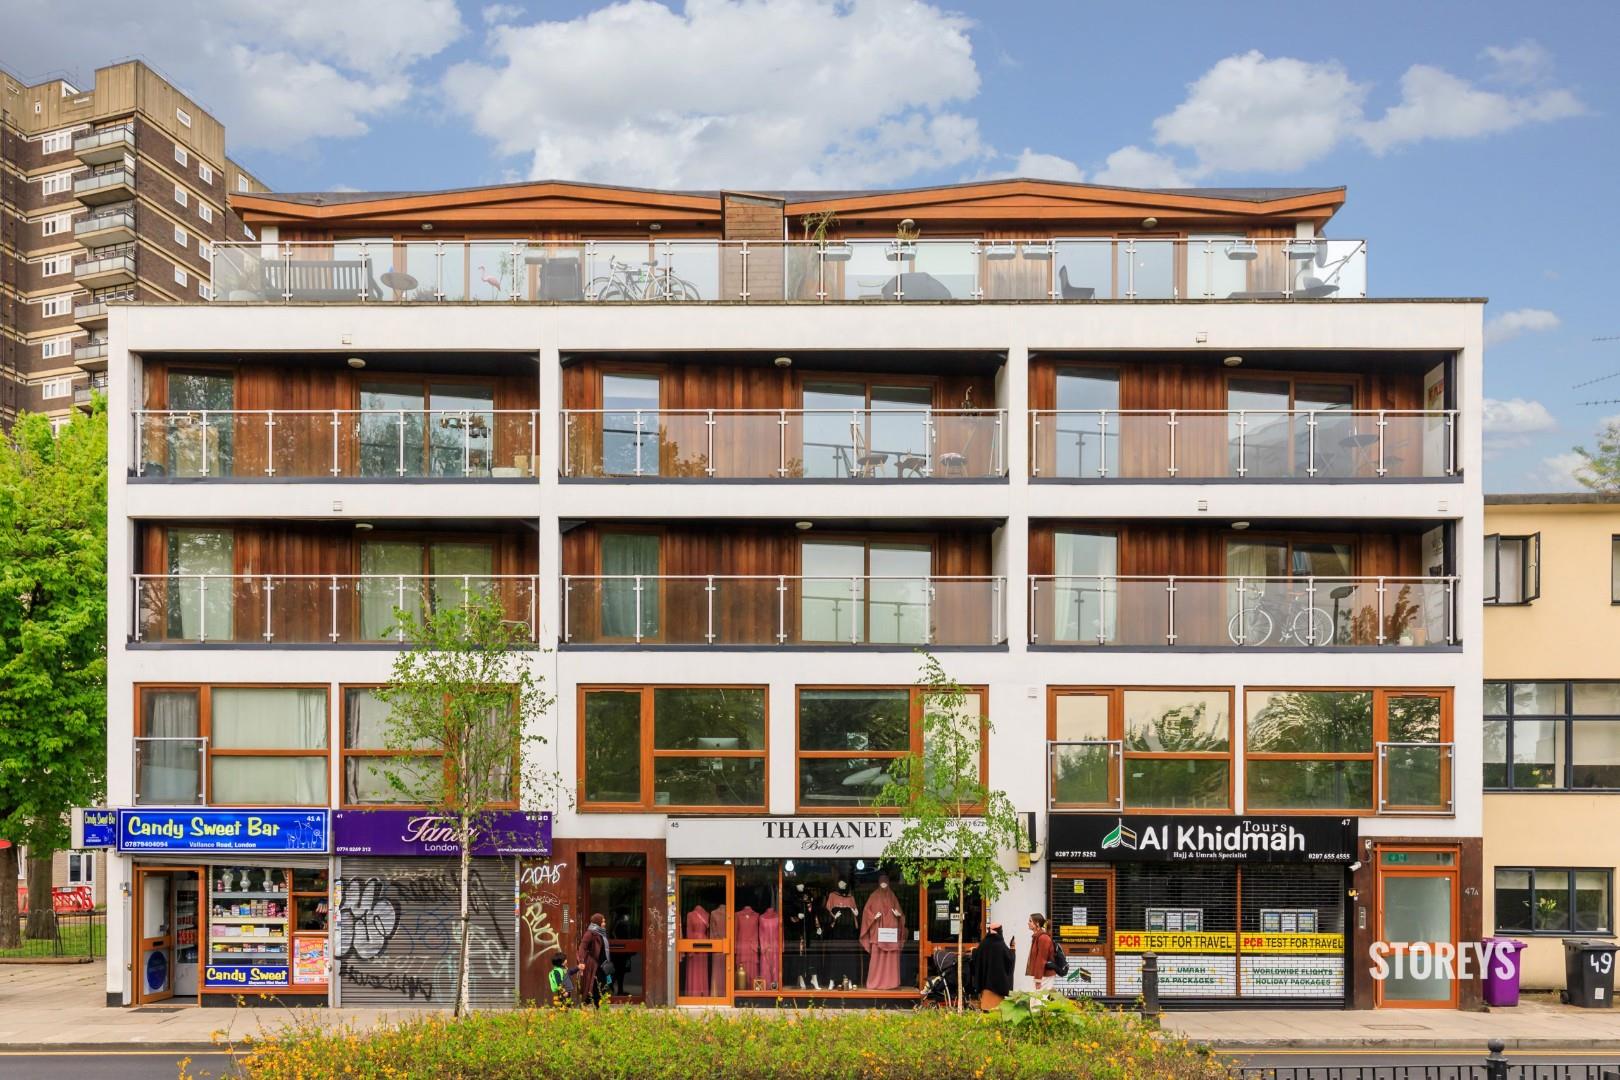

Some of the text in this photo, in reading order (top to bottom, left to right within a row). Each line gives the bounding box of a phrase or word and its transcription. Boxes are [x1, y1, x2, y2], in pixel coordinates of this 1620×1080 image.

[128, 816, 280, 839] Candy Sweet Bar
[762, 821, 893, 838] THAHANEE
[1243, 820, 1287, 832] Tours
[1139, 826, 1306, 851] Al Khidmah
[424, 844, 458, 852] London
[800, 839, 854, 854] Boutique
[1118, 936, 1232, 949] PCR TEST FOR TRAVEL
[1244, 938, 1344, 949] PCR TEST FOR TRAVEL
[1590, 952, 1612, 974] 49
[206, 968, 288, 982] Candy Sweet
